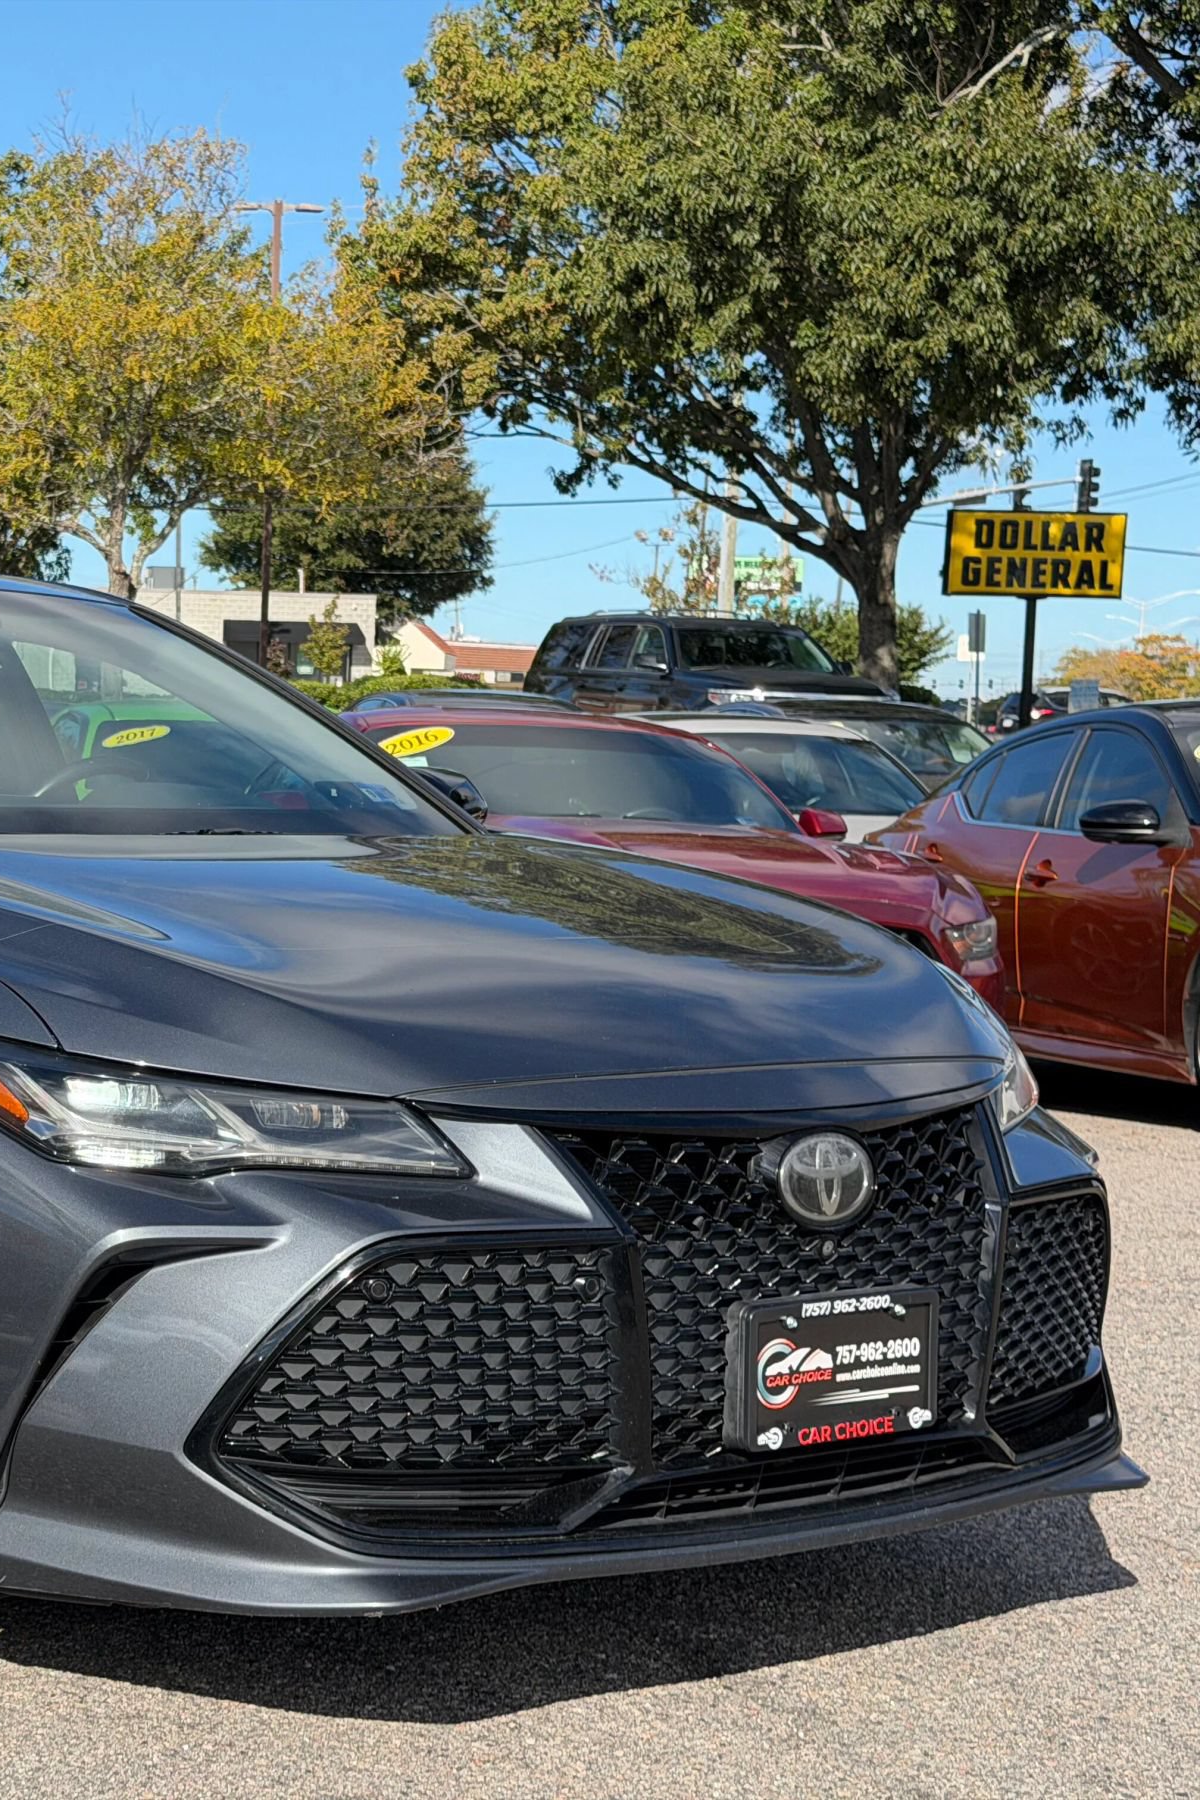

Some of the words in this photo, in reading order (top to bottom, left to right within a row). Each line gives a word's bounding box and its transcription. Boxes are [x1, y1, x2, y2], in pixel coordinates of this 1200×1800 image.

[974, 518, 1105, 553] DOLLAR
[960, 556, 1114, 591] GENERAL
[115, 728, 156, 745] 2017
[385, 730, 439, 755] 2016
[801, 1300, 831, 1319] (757)
[832, 1294, 891, 1314] 962-2600
[836, 1337, 920, 1366] 757-962-2600
[766, 1375, 790, 1388] CAR
[791, 1369, 833, 1385] CHOICE
[798, 1425, 832, 1446] CAR
[834, 1416, 895, 1441] CHOICE
